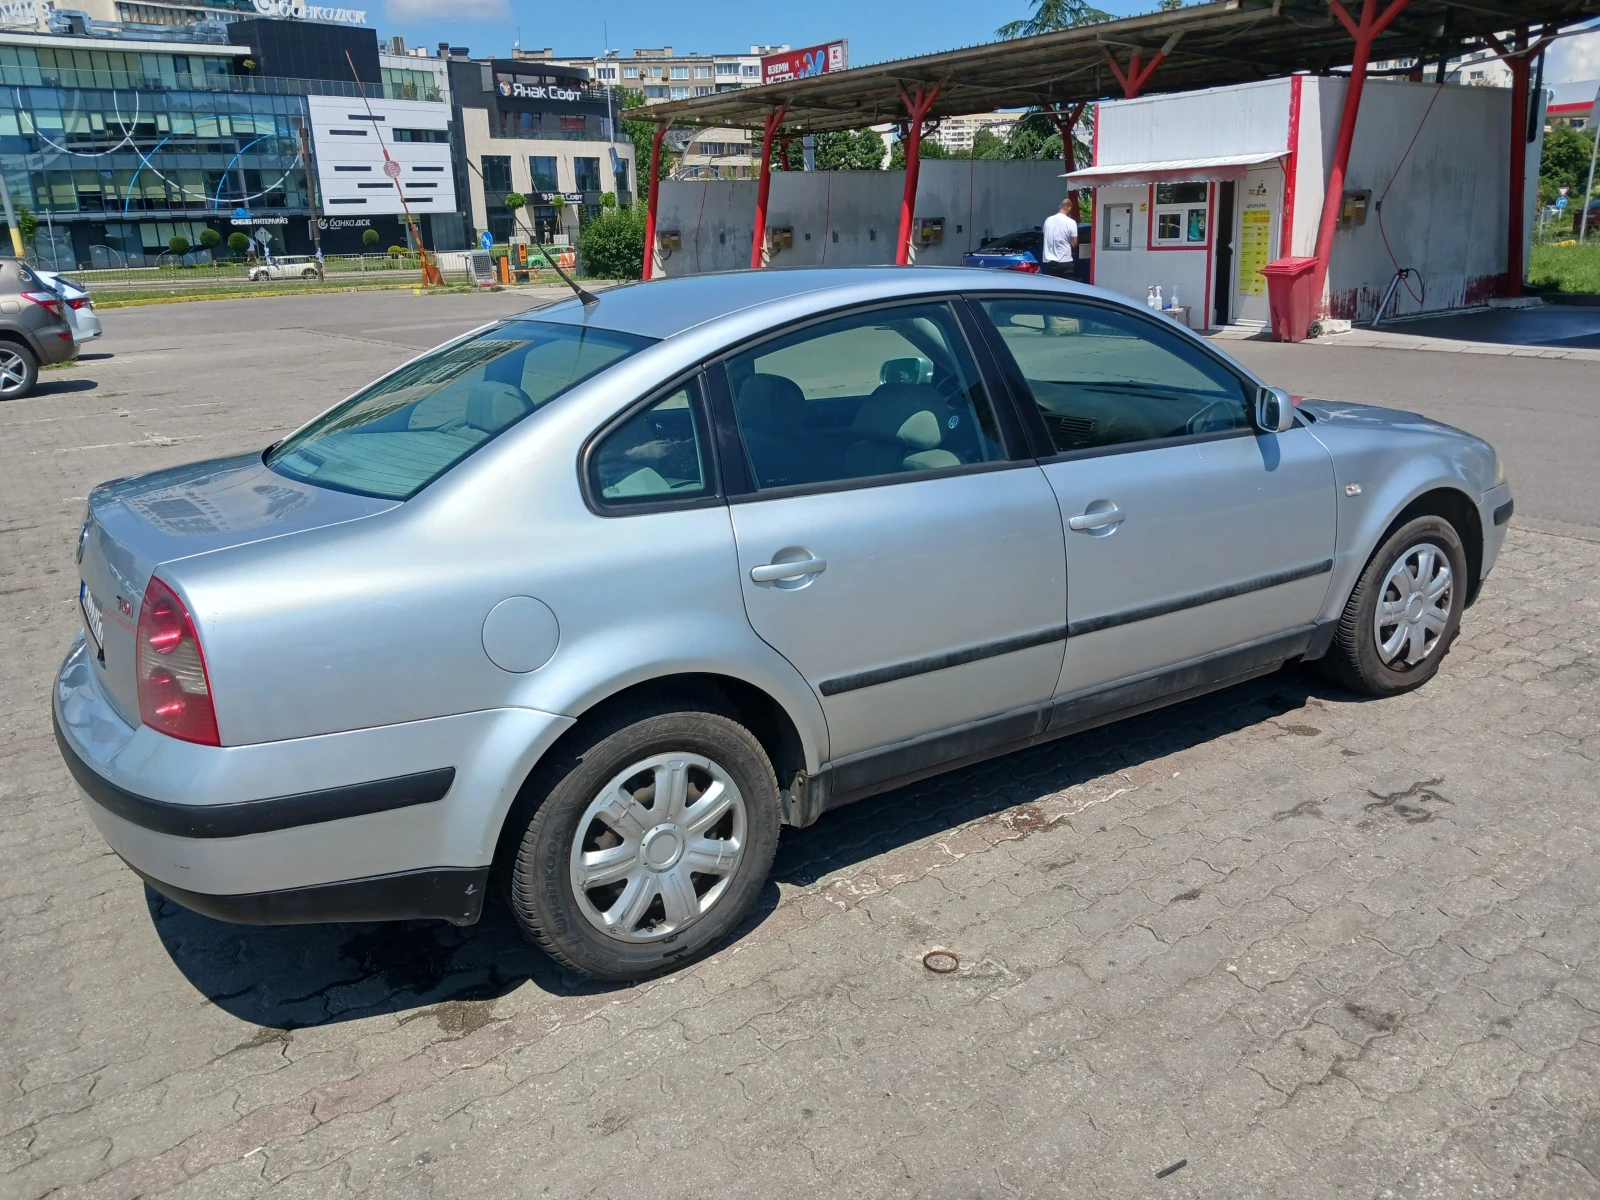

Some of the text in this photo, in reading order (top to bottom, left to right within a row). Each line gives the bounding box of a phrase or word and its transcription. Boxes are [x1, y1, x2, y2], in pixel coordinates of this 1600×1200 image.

[767, 62, 789, 75] ВЗЕМИ
[513, 83, 581, 101] Янак Софт
[329, 217, 354, 227] банка
